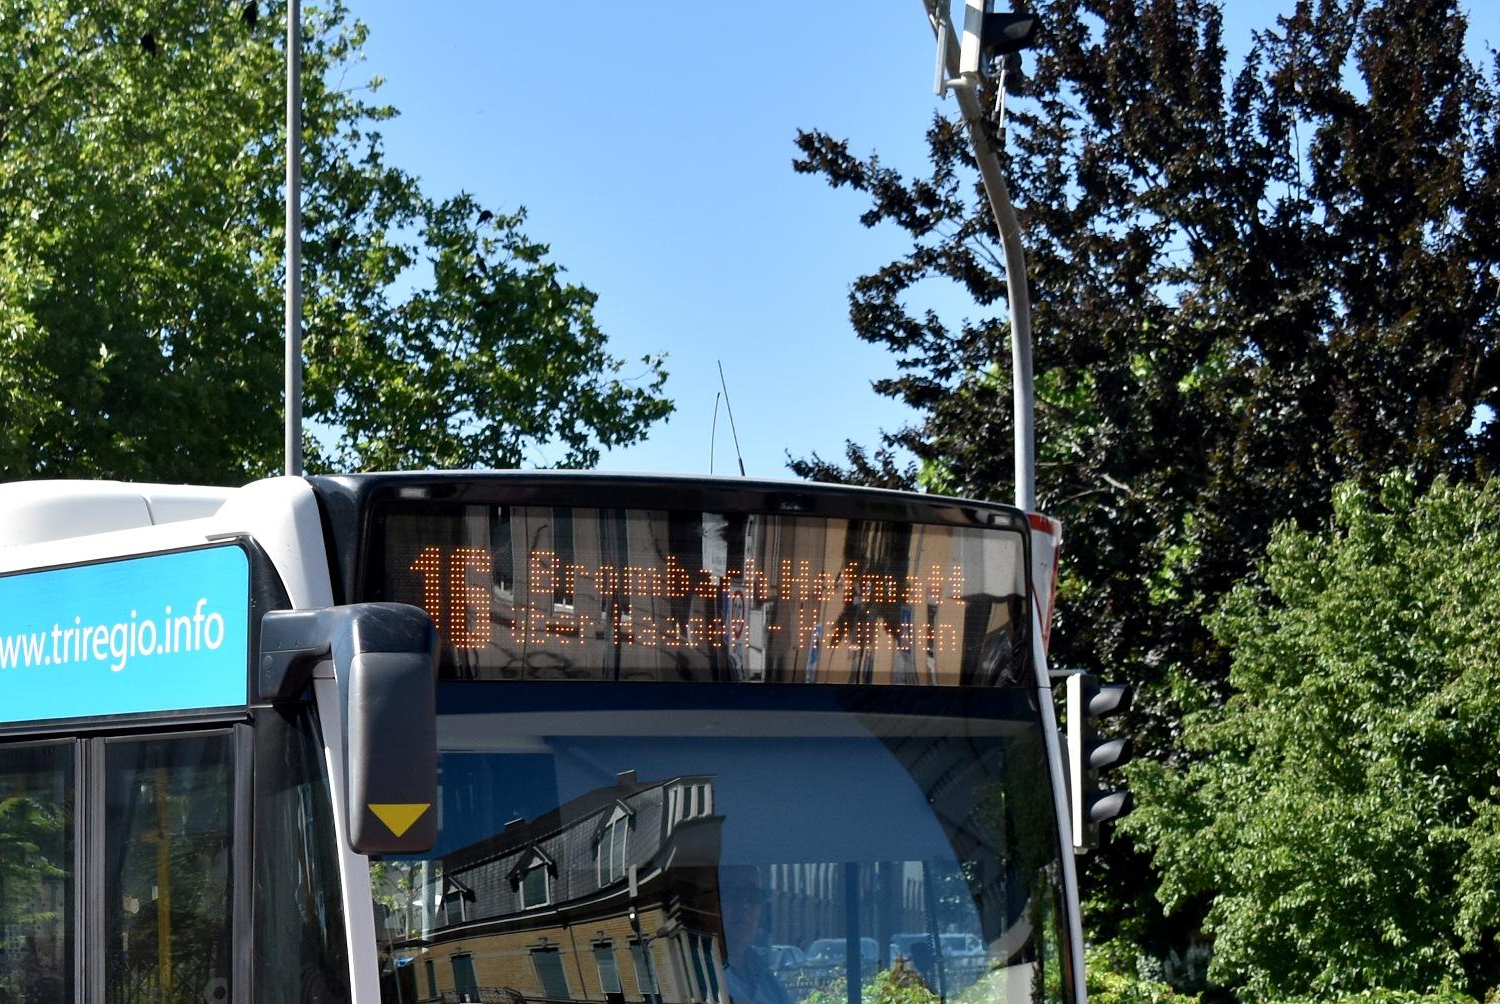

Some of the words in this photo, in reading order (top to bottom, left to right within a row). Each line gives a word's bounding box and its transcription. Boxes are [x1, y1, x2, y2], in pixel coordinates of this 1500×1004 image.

[409, 546, 490, 649] 16
[531, 551, 768, 598] Brombach
[782, 559, 965, 605] Hofmatt
[511, 602, 594, 643] über
[614, 604, 749, 647] Haagen
[800, 609, 956, 650] Hauingen
